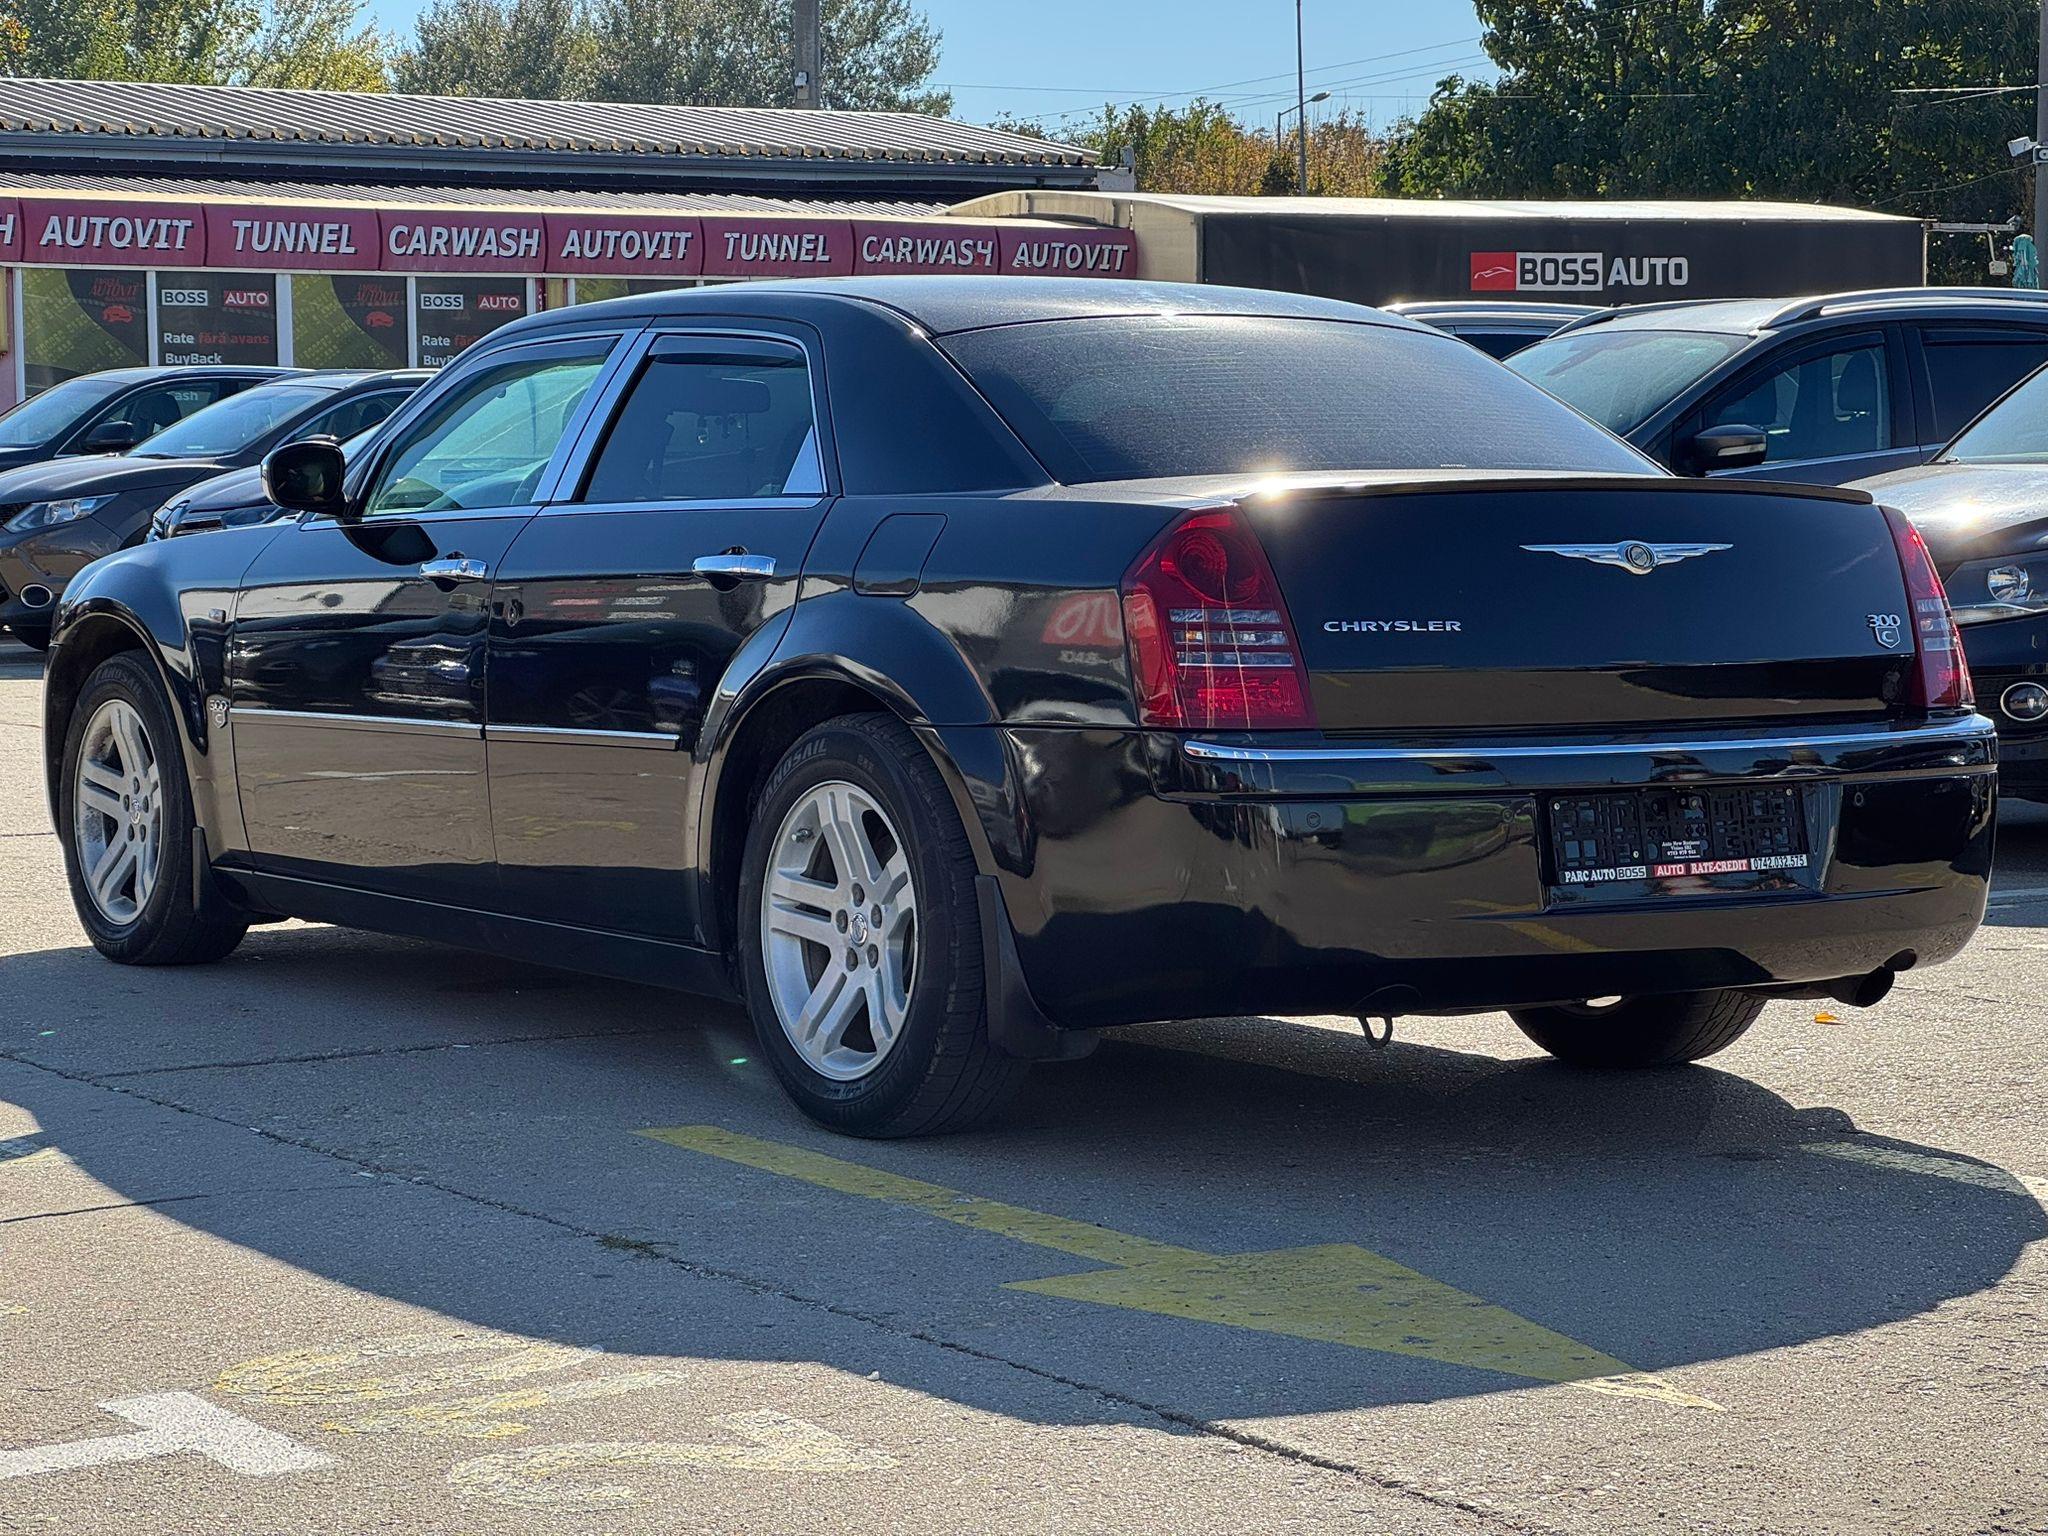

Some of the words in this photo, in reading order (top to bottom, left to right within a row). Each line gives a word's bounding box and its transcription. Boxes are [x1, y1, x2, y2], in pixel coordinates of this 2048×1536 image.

[39, 215, 194, 249] AUTOVIT
[232, 219, 356, 254] TUNNEL
[388, 225, 540, 258] CARWASH
[560, 229, 692, 260] AUTOVIT
[724, 232, 830, 262] TUNNEL
[1012, 241, 1129, 271] AUTOVIT
[1519, 256, 1600, 286] BOSS
[1607, 256, 1689, 286] AUTO
[164, 291, 206, 304] BOSS
[225, 291, 269, 305] AUTO
[422, 295, 462, 308] BOSS
[478, 296, 519, 309] AUTO
[163, 332, 195, 344] Rate
[231, 335, 270, 345] avans
[421, 335, 451, 347] Rate
[165, 352, 223, 366] BuyBack
[1323, 620, 1463, 633] CHRYSLER
[1867, 614, 1901, 627] 300
[1882, 631, 1894, 642] C
[1565, 869, 1590, 883] PARC
[1590, 867, 1616, 881] AUTO
[1618, 866, 1646, 879] BOSS
[1656, 863, 1685, 876] AUTO
